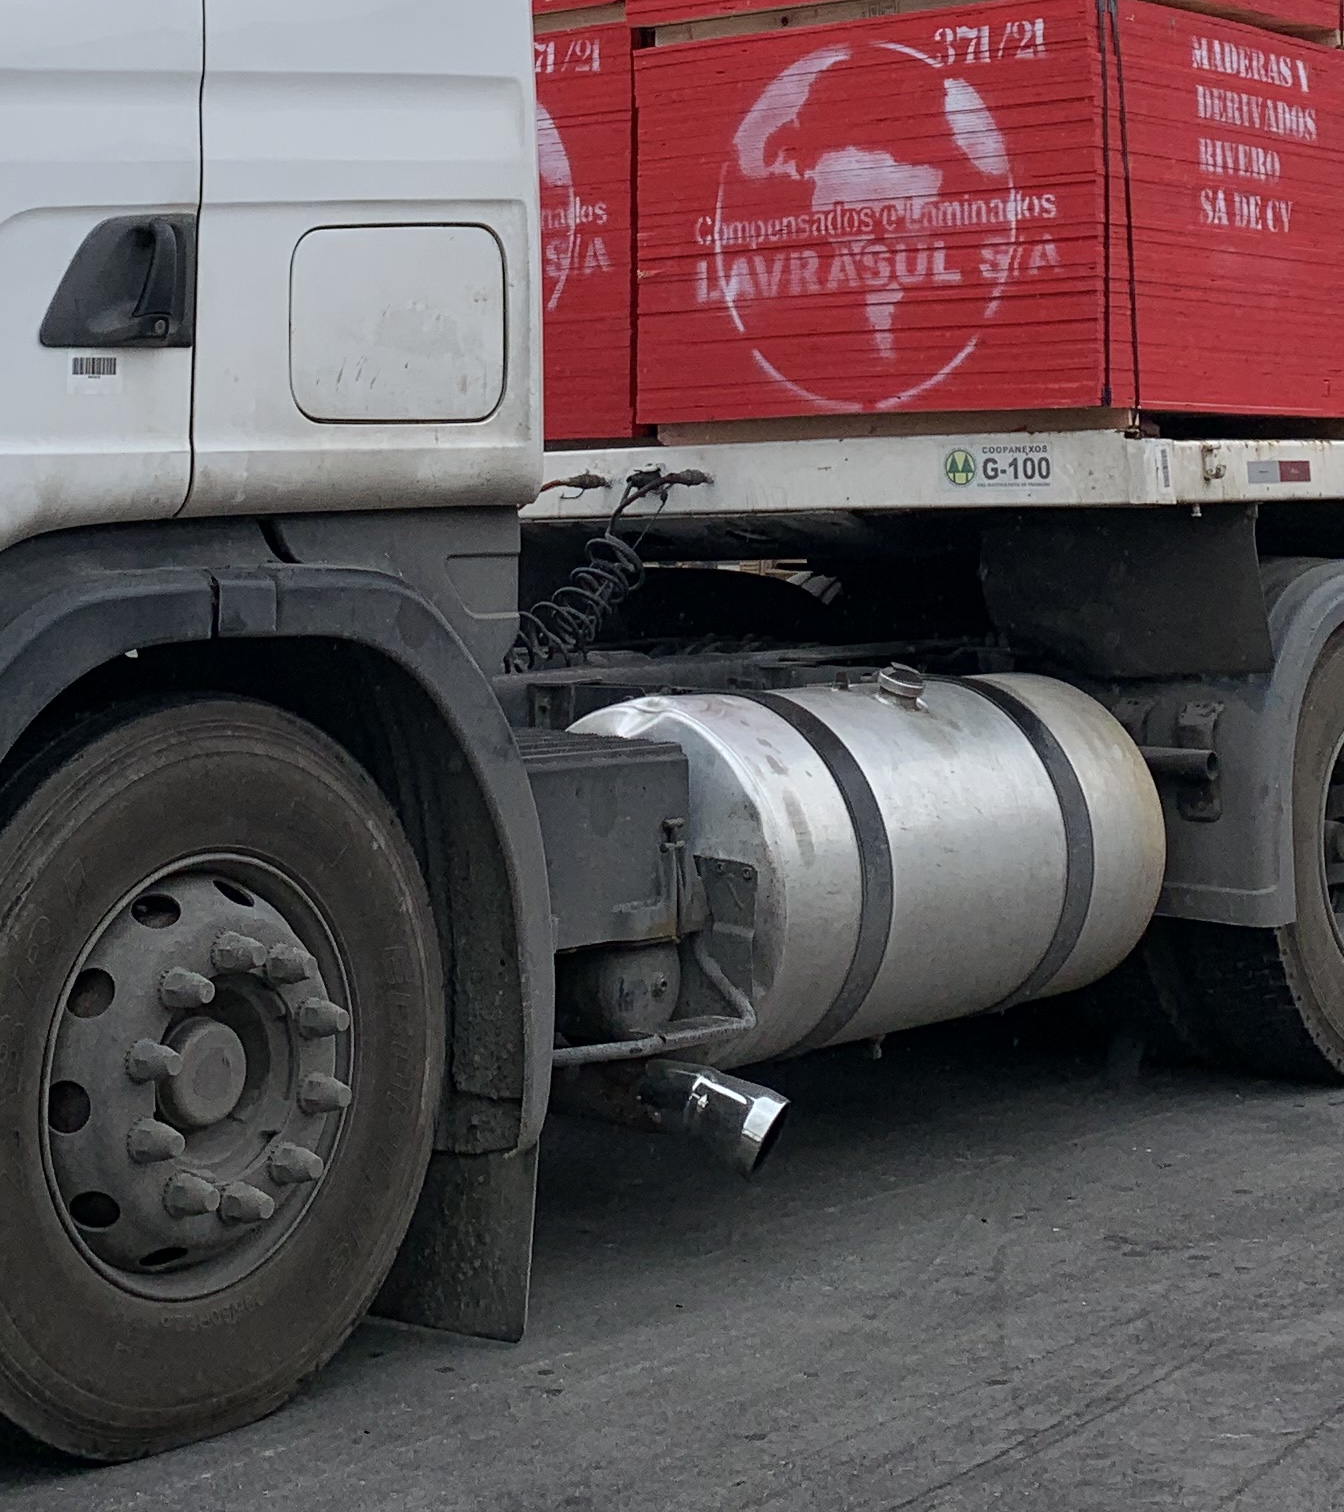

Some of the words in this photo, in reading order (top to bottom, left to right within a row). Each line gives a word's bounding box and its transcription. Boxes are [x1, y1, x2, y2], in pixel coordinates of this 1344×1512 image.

[535, 38, 601, 74] 71/21
[935, 18, 1046, 68] 371/21
[1192, 36, 1294, 88] MADERAS
[1196, 85, 1317, 142] DERIVADOS
[1198, 137, 1281, 183] RIVERO
[695, 199, 874, 245] Compensados
[907, 192, 1058, 229] Laminados
[1201, 187, 1229, 226] SA
[1233, 192, 1262, 230] DE
[1265, 199, 1293, 233] CV
[545, 233, 613, 279] S/A
[695, 238, 962, 304] LAVRASUL
[978, 233, 1062, 279] S/A
[982, 445, 1048, 455] COOPANEXOS
[982, 456, 1051, 480] G-100
